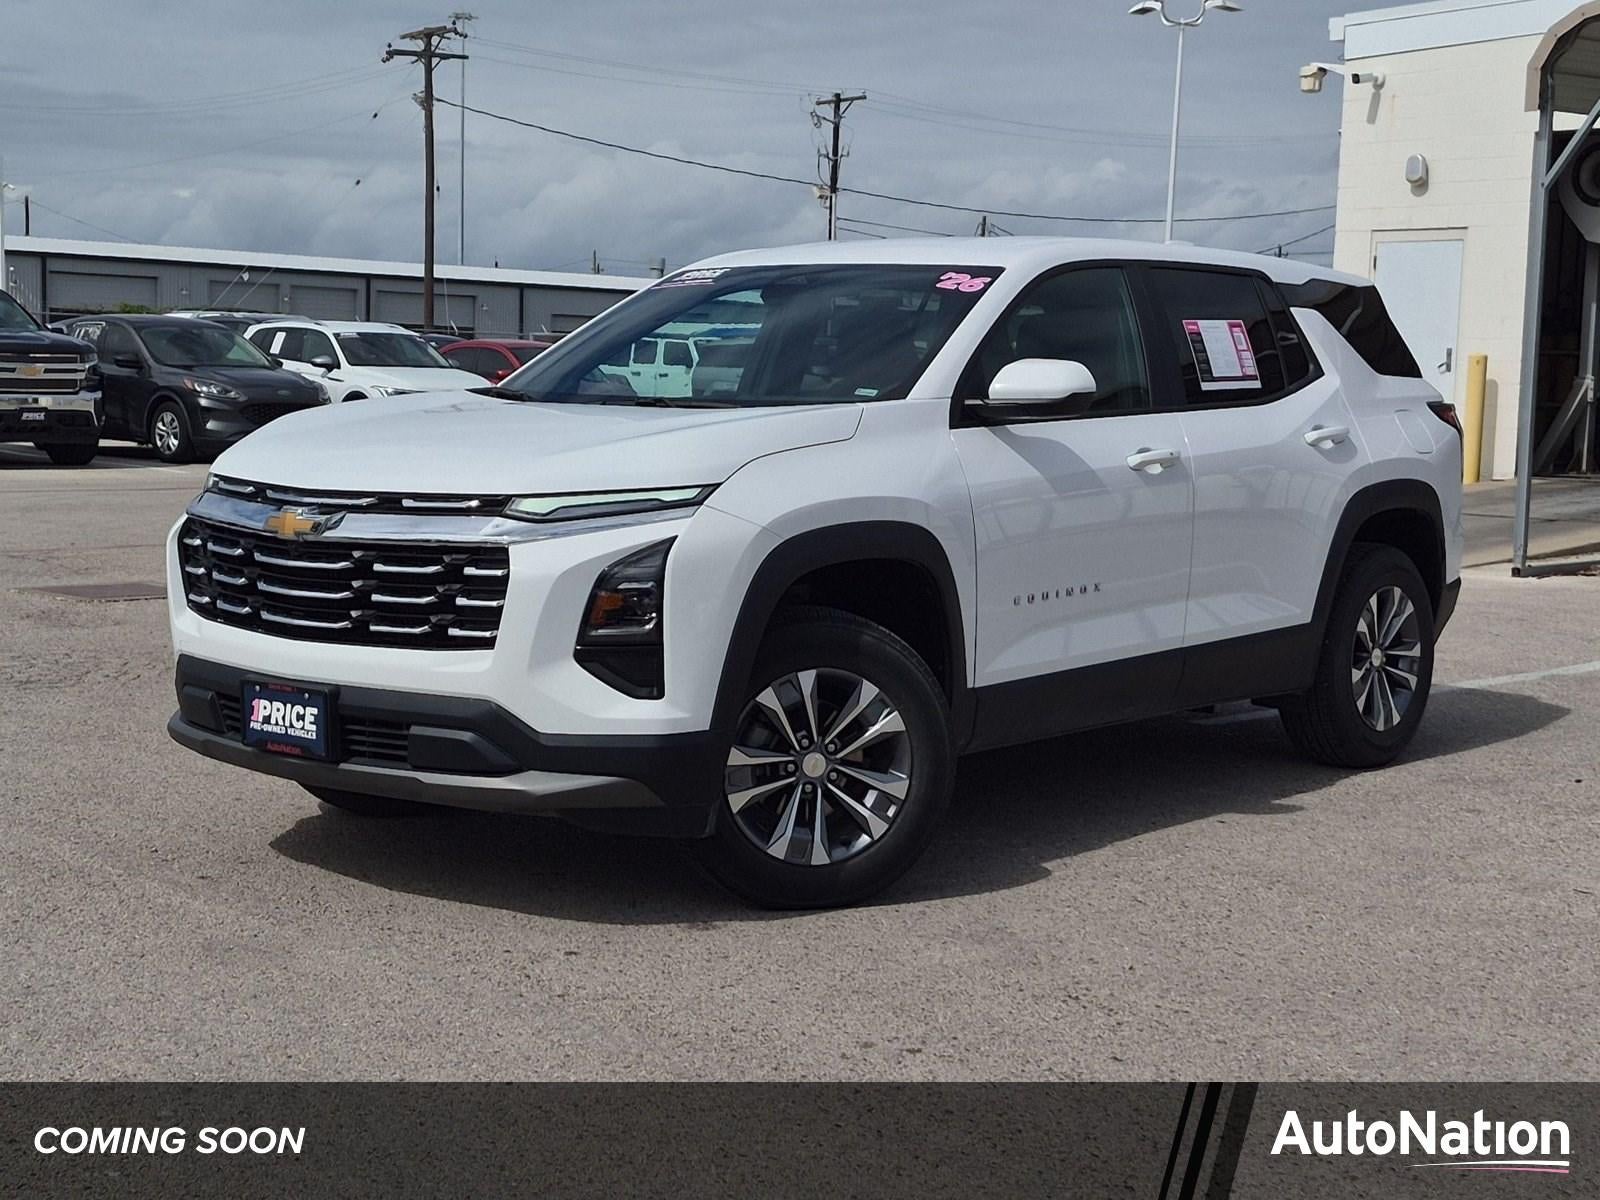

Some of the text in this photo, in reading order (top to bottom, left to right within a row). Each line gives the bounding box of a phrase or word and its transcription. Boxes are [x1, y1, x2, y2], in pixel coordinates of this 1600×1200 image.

[1013, 582, 1101, 606] EQUINOX
[250, 698, 318, 731] 1PRICE
[249, 721, 317, 740] PRE-OWNED VEHICLES
